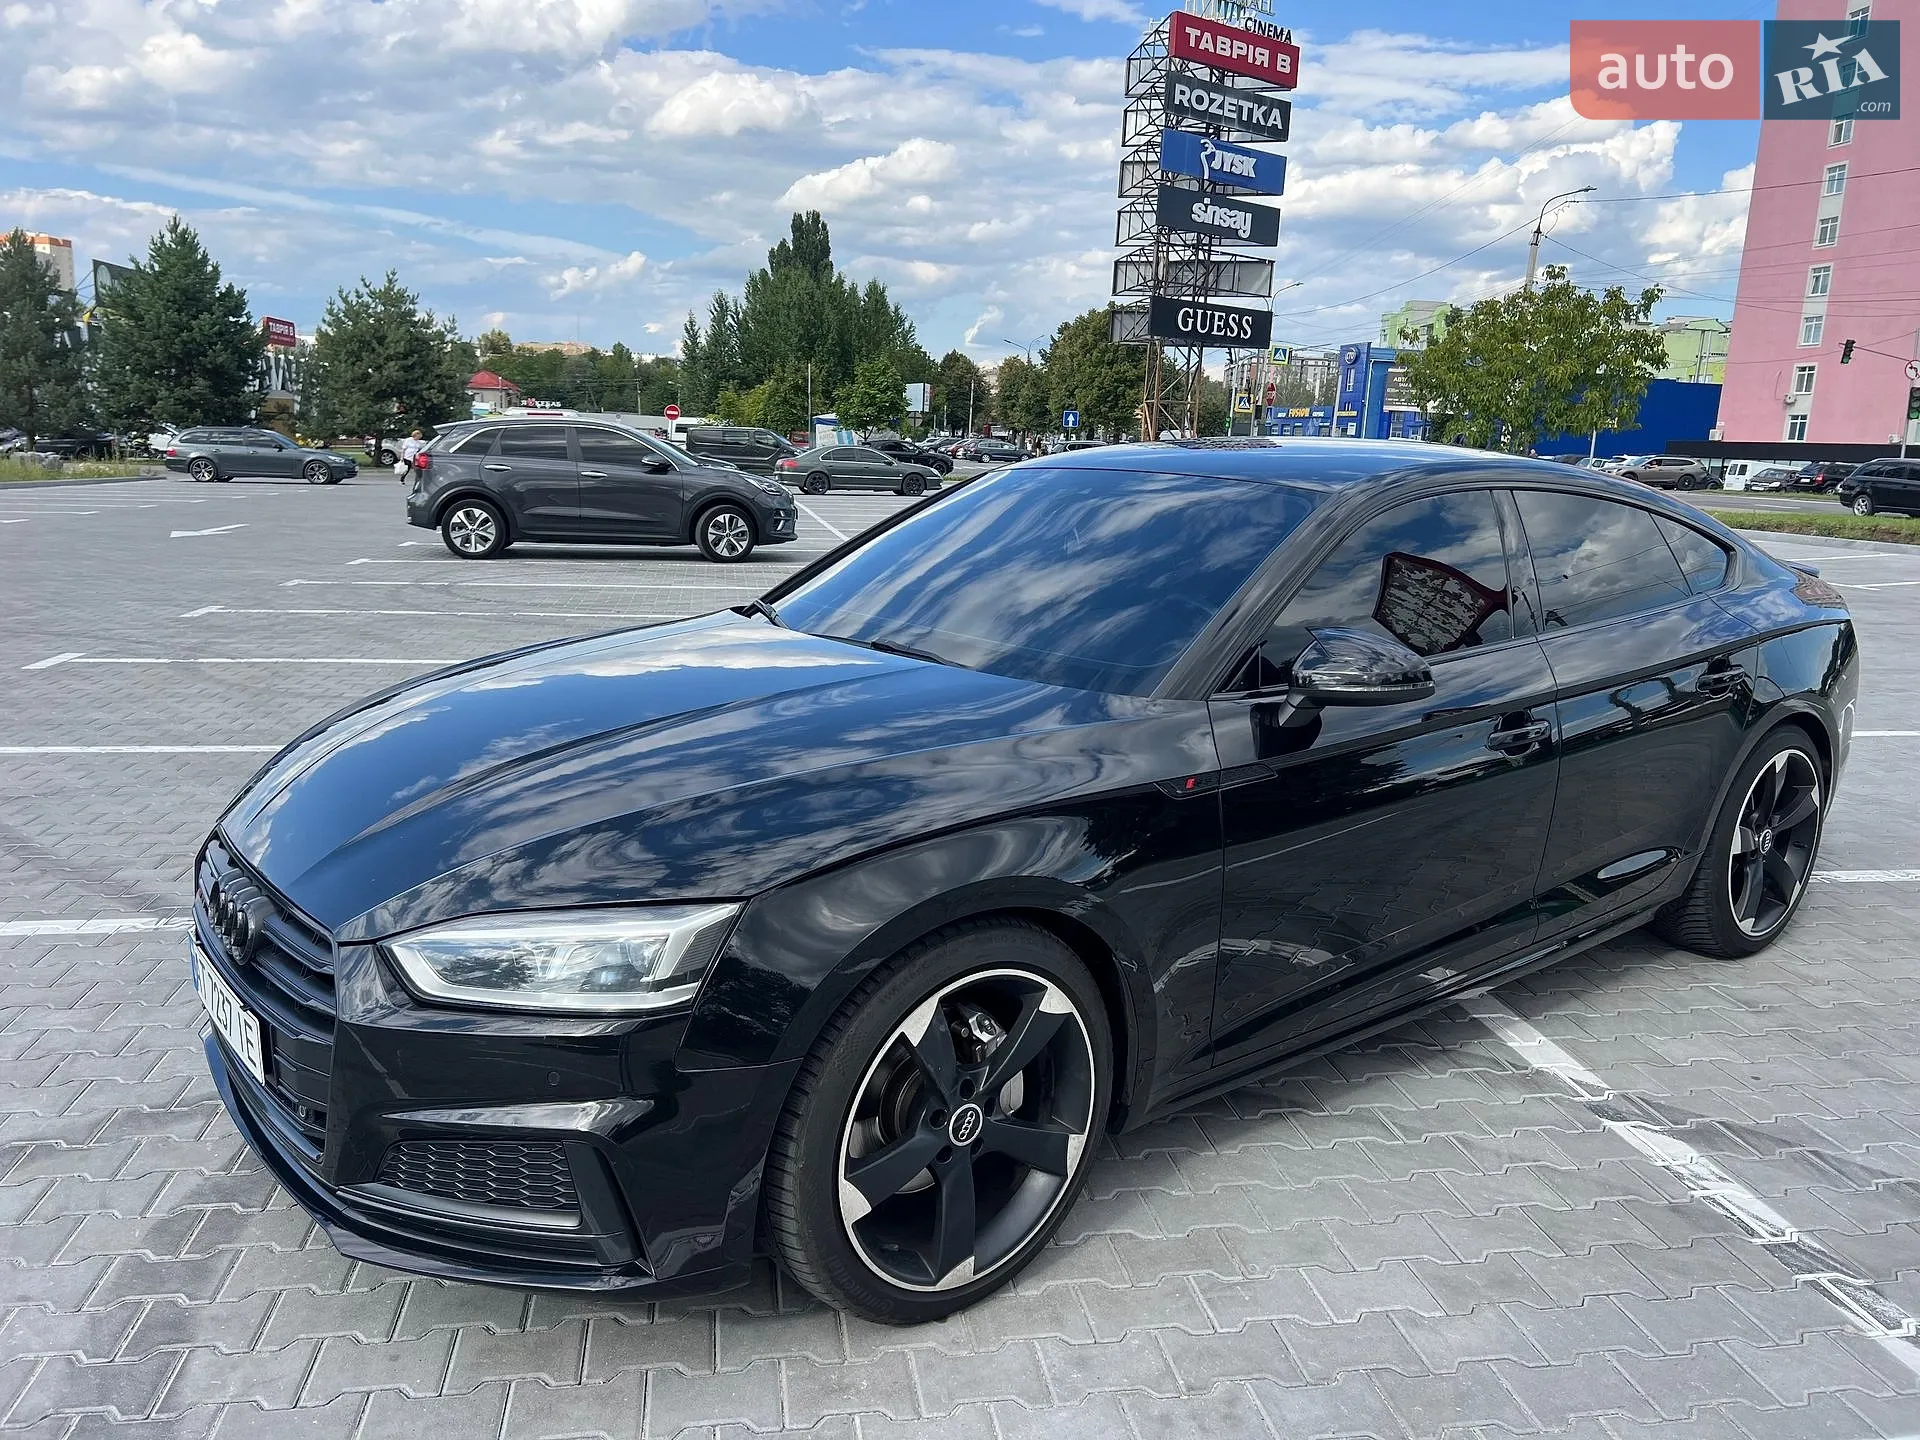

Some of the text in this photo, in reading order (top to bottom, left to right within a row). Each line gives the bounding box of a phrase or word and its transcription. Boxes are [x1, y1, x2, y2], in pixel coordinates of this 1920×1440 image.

[1245, 17, 1292, 44] CINEMA
[1185, 26, 1291, 74] ТАВРІЯ В
[1174, 83, 1283, 130] ROZETKA
[1210, 150, 1257, 178] JYSK
[1191, 198, 1252, 239] sinsay
[1177, 307, 1253, 340] GUESS
